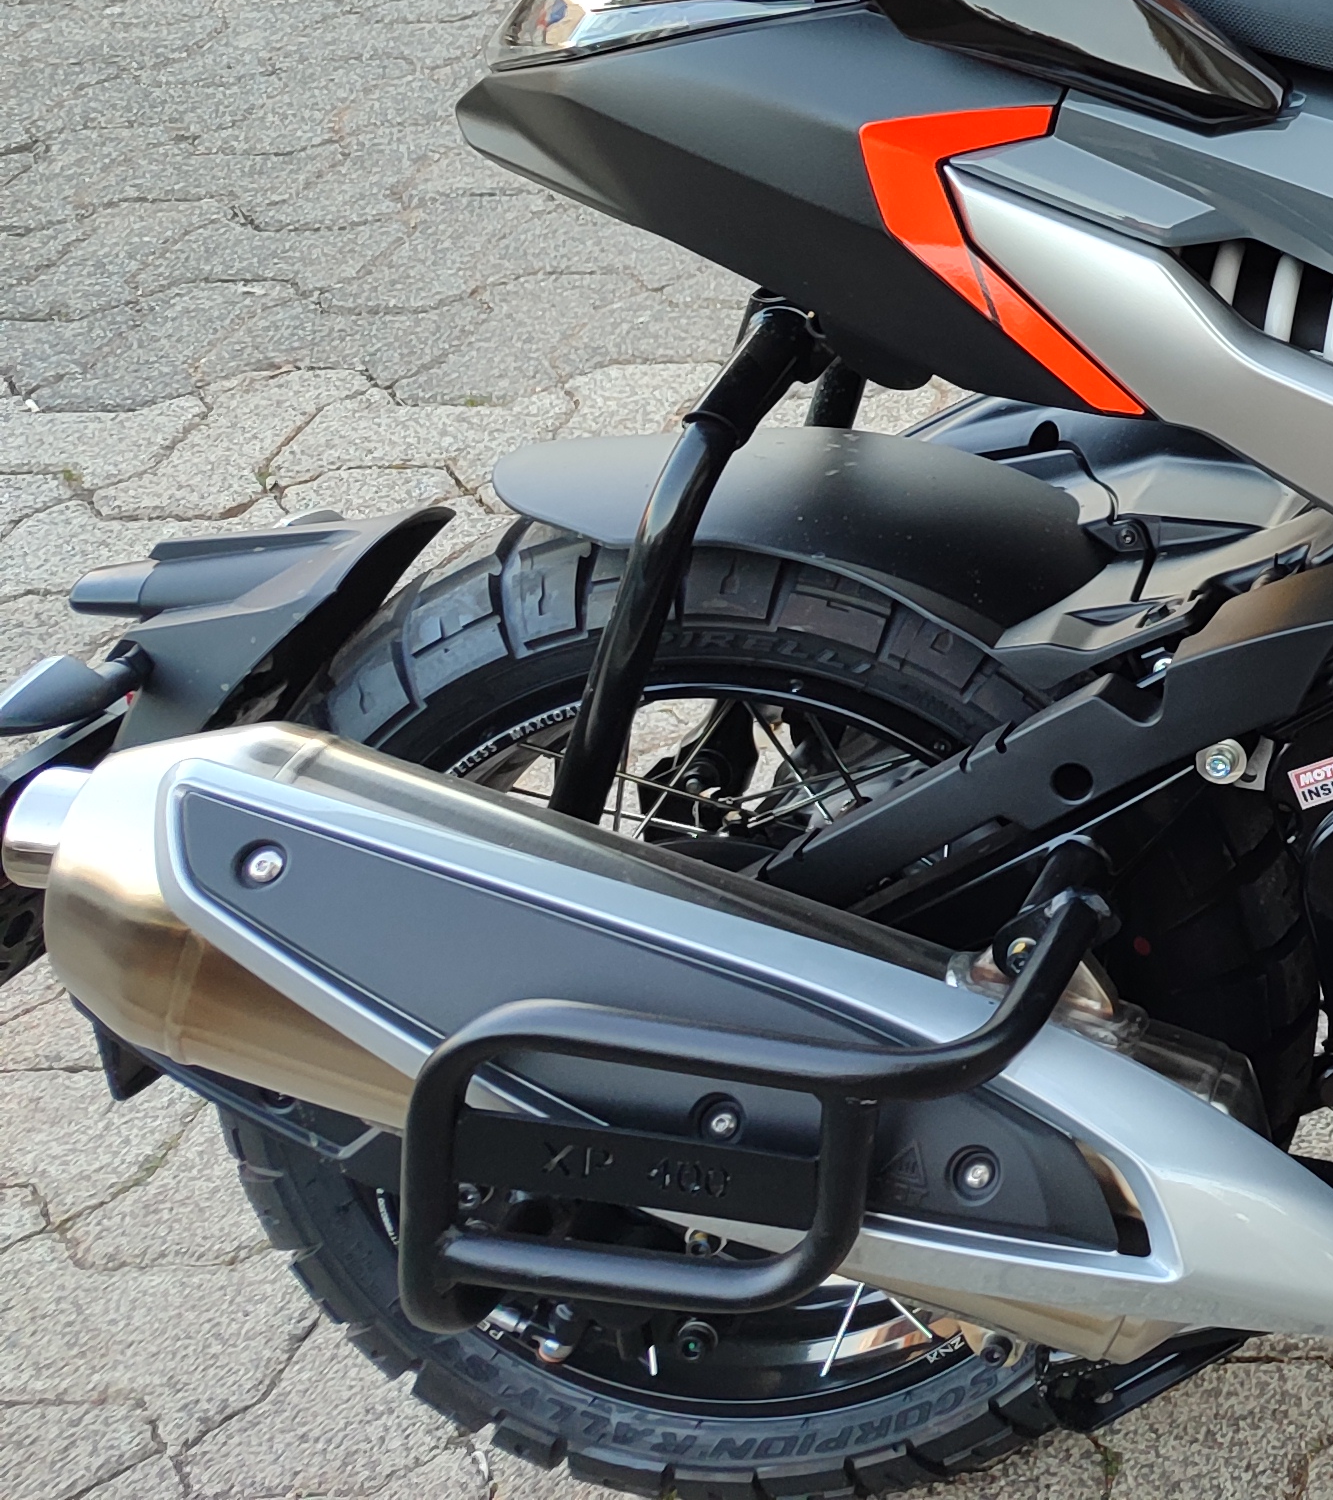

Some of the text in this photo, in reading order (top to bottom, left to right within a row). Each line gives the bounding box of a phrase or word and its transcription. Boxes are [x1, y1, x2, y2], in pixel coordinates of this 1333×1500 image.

[541, 1142, 732, 1198] XP 400
[711, 1372, 1000, 1461] SCORPION
